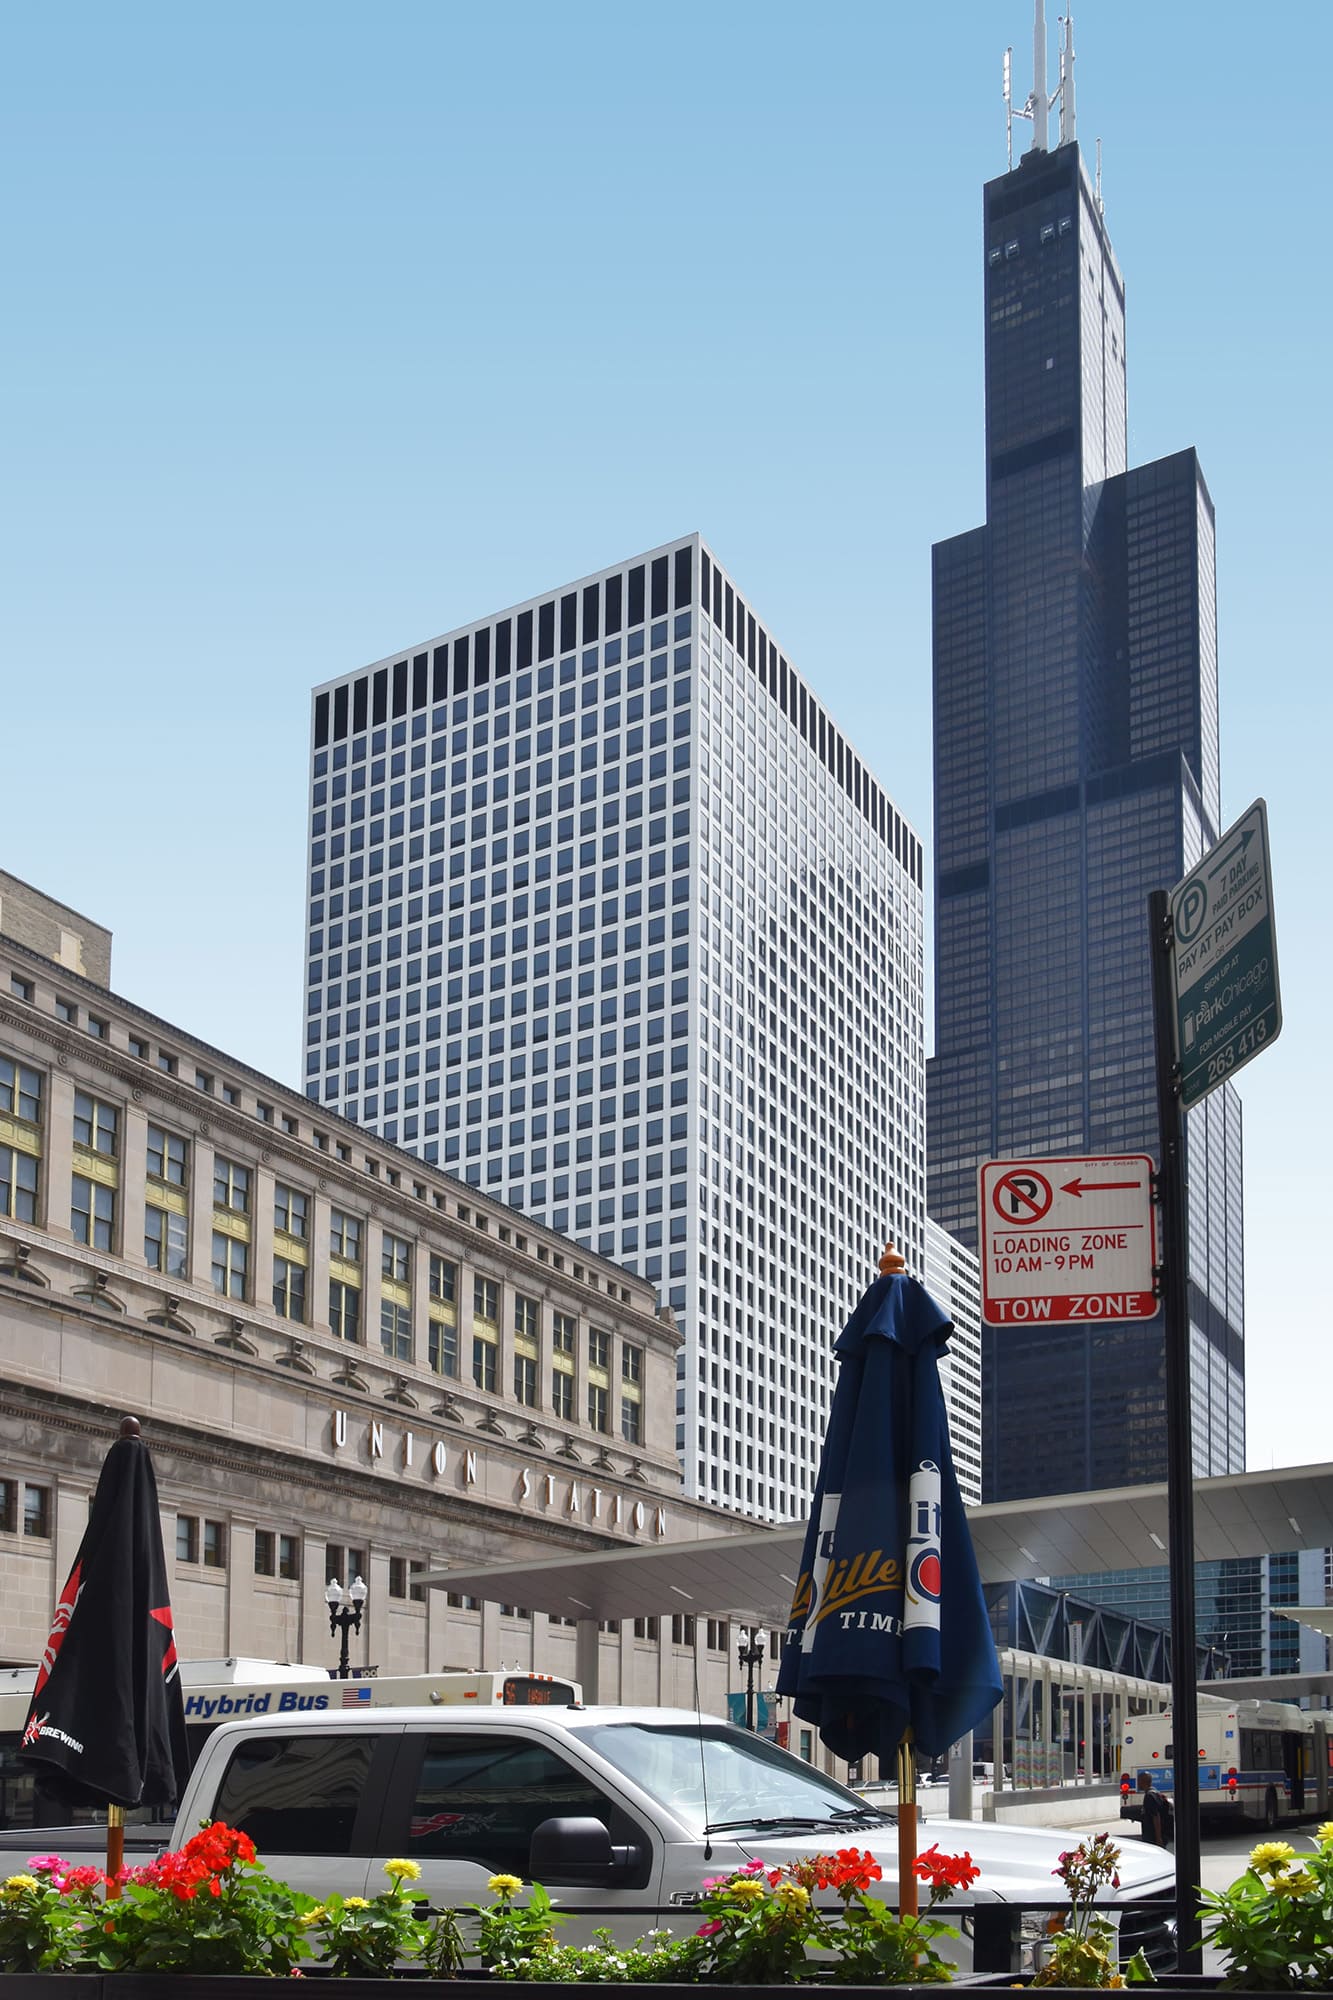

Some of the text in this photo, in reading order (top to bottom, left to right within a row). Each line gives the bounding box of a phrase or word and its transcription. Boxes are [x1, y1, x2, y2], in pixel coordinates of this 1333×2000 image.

[1212, 862, 1259, 915] PAID PARKING
[1221, 855, 1247, 891] 7 DAY
[1179, 885, 1263, 978] PAY AT PAY BOX
[1215, 945, 1225, 958] OR
[1204, 954, 1240, 993] SIGN UP AT
[1195, 957, 1269, 1032] ParkChicago
[1199, 1003, 1253, 1055] FOR MOBILE PAY
[1208, 1046, 1235, 1084] 263
[1238, 1018, 1267, 1055] 413
[993, 1233, 1128, 1255] LOADING ZONE
[994, 1257, 1012, 1274] 10
[1069, 1254, 1094, 1270] PM
[995, 1294, 1142, 1321] TOW ZONE
[332, 1410, 666, 1537] UNION STATION
[184, 1691, 329, 1719] Hybrid Bus
[39, 1726, 84, 1754] BREWING
